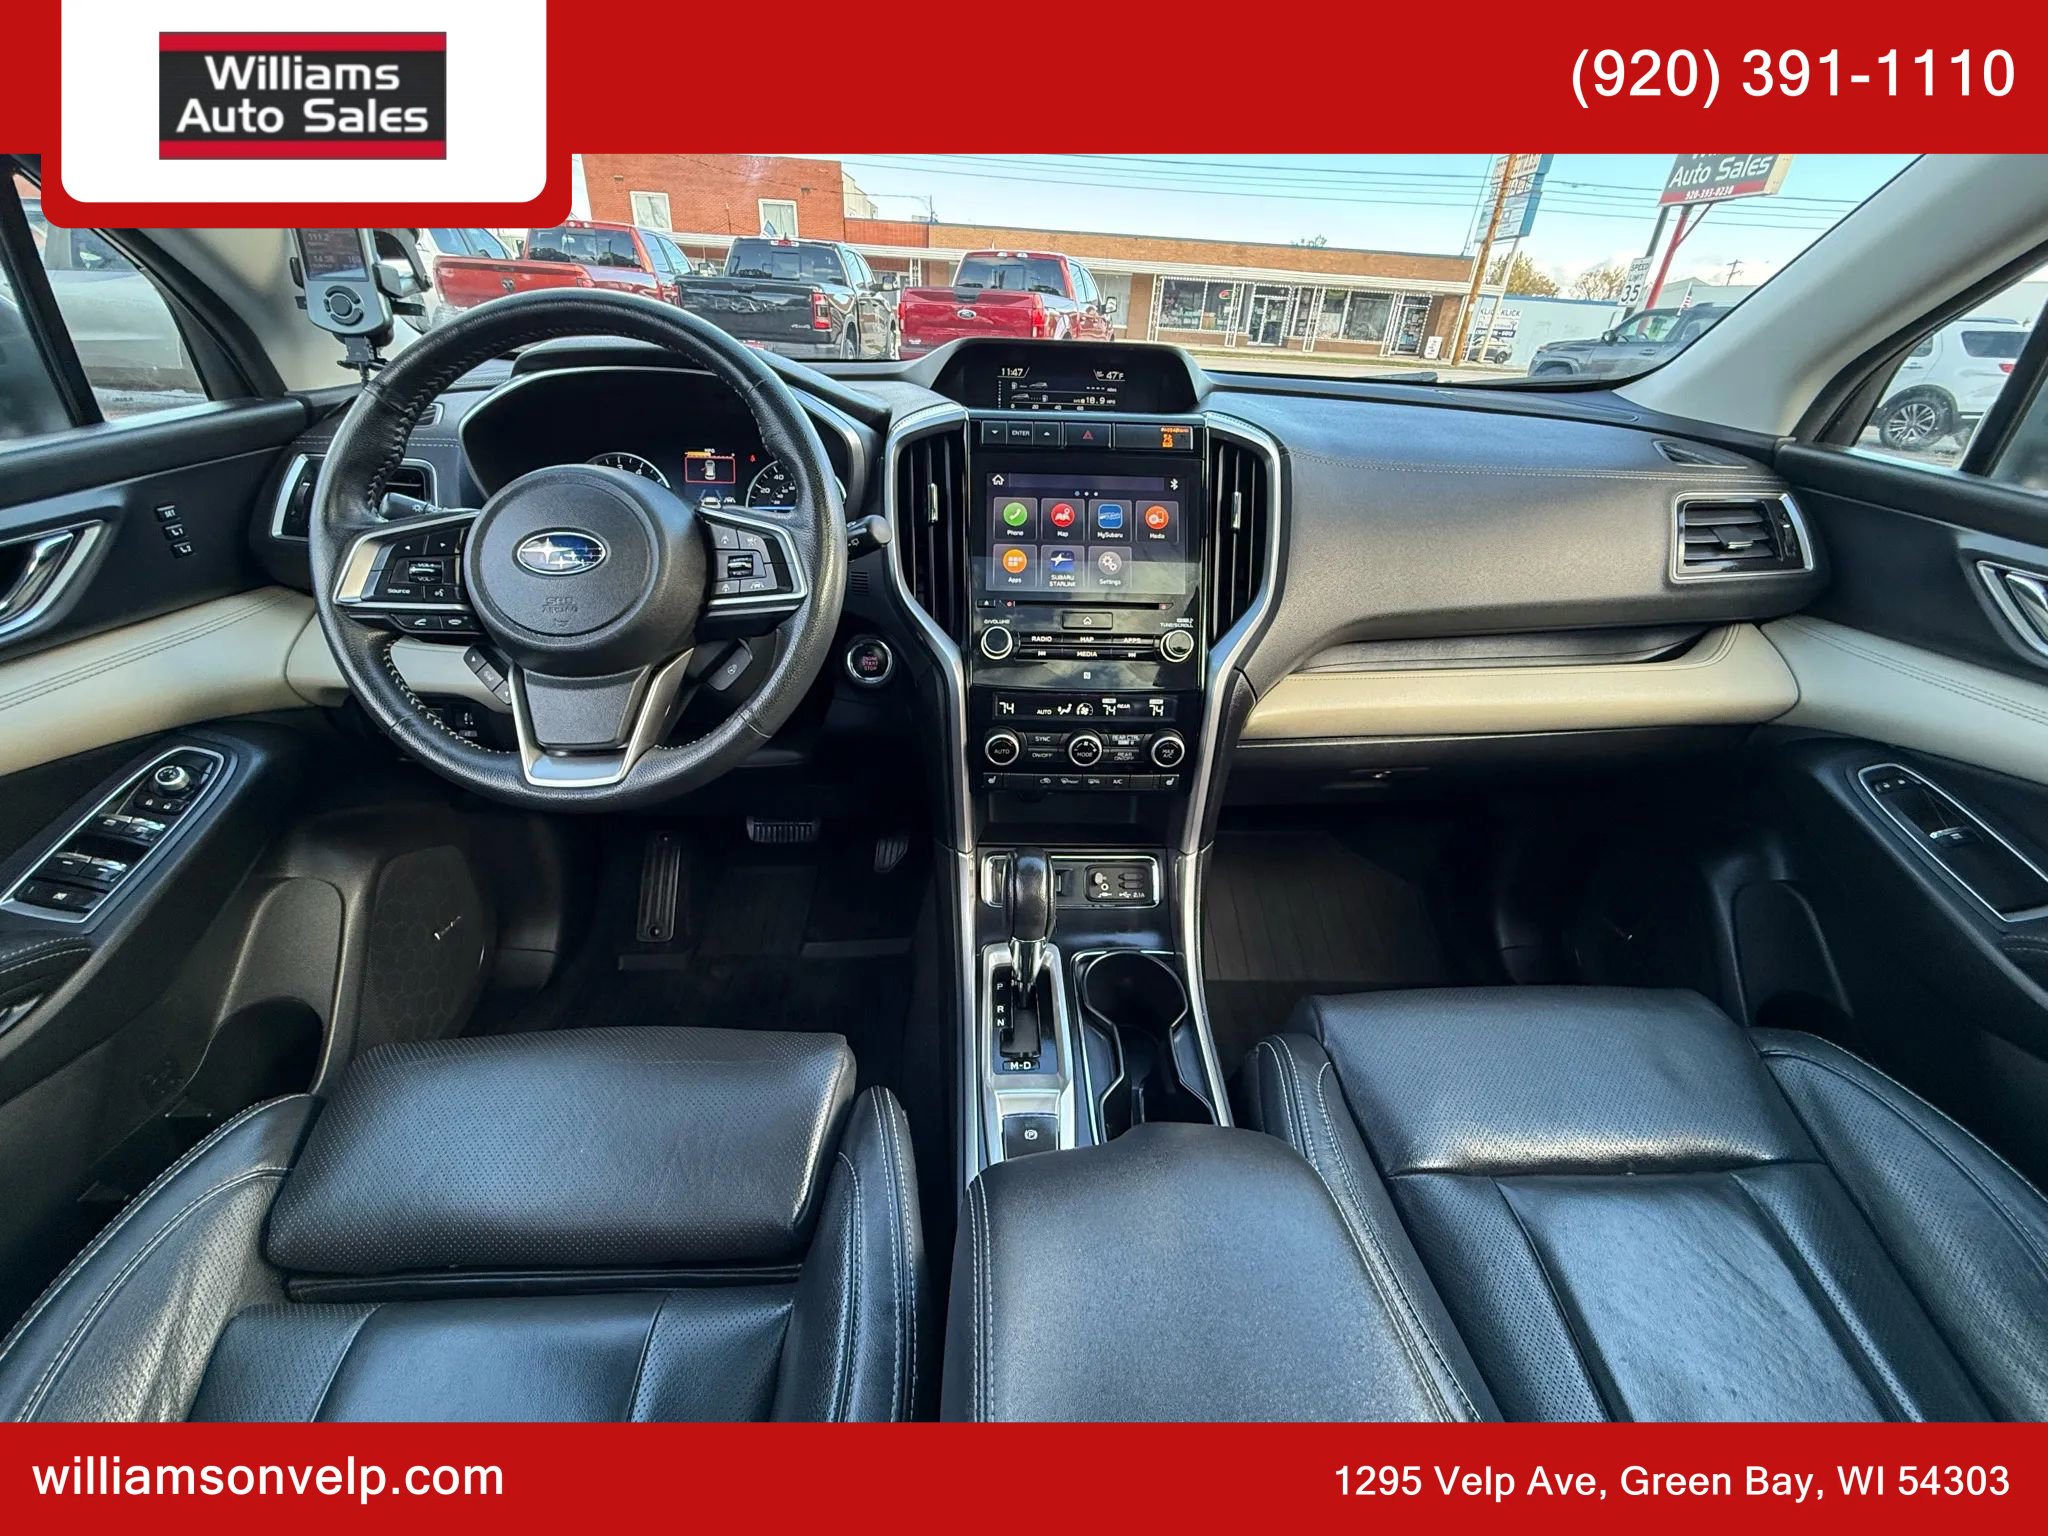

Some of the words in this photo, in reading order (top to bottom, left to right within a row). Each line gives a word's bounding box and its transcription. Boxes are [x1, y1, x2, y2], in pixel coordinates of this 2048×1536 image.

[1668, 163, 1711, 188] Auto
[1715, 154, 1773, 181] Sales
[1631, 263, 1649, 271] SPEED
[1621, 284, 1641, 302] 35
[1001, 368, 1023, 376] 11:47
[1086, 397, 1106, 405] 18.9
[1097, 531, 1123, 539] MySubaru
[999, 702, 1015, 714] 74
[1102, 704, 1116, 716] 74
[1149, 704, 1164, 717] 74
[996, 1005, 1004, 1013] R
